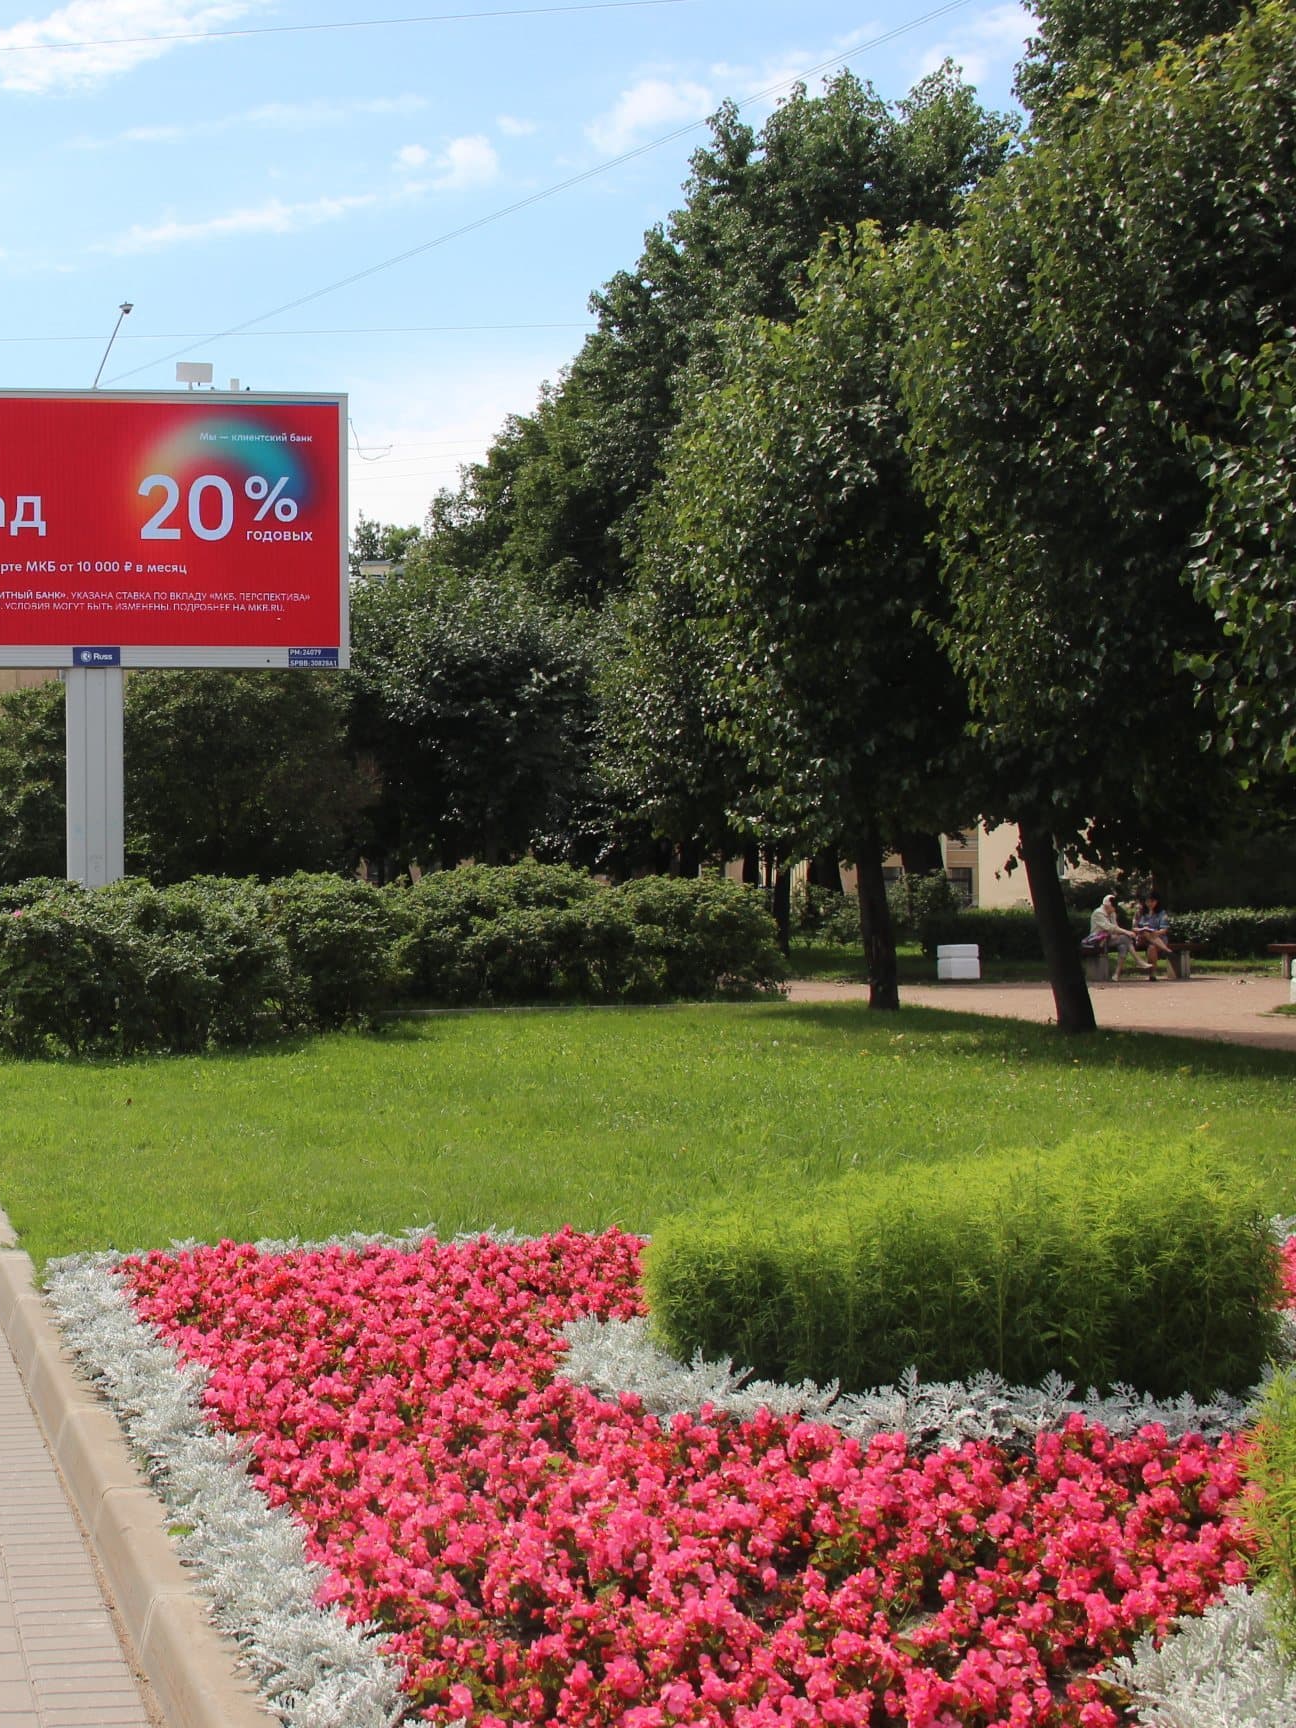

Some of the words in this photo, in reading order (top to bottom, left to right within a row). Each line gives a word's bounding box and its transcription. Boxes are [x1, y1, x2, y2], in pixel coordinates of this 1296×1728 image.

[199, 432, 217, 441] Мы
[231, 431, 288, 442] клиентский
[290, 432, 313, 442] банк
[246, 530, 313, 542] годовых
[26, 560, 56, 572] МКБ
[59, 563, 74, 572] от
[77, 561, 91, 572] 10
[95, 561, 120, 572] 000
[136, 564, 143, 573] в
[147, 564, 187, 575] месяц
[71, 591, 114, 600] УКАЗАНА
[115, 591, 152, 600] СТАВКА
[154, 592, 167, 600] ПО
[169, 592, 207, 602] ВКЛАДУ
[5, 602, 50, 610] УСЛОВИЯ
[52, 602, 85, 611] МОГУТ
[87, 602, 113, 611] БЫТЬ
[232, 604, 246, 612] НА
[93, 652, 113, 661] Russ
